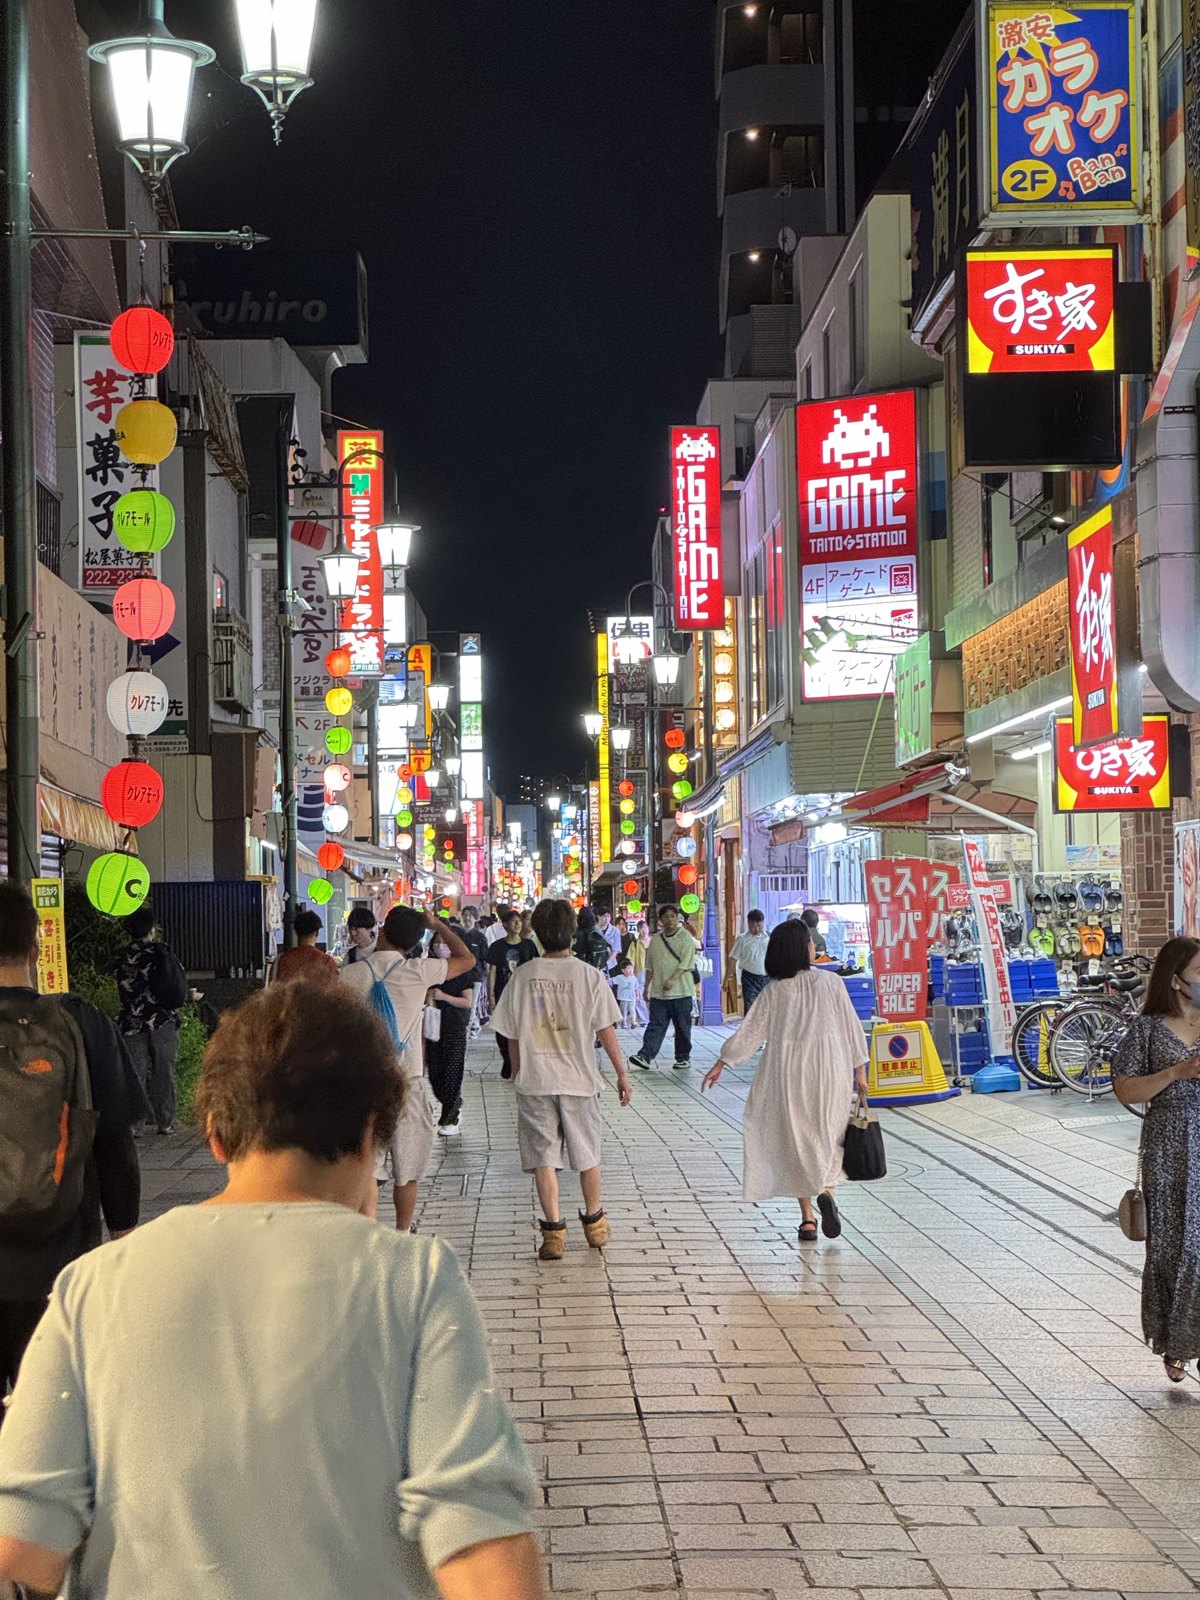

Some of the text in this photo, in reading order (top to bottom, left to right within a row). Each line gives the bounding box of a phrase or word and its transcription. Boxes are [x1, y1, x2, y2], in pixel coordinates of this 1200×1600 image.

[998, 13, 1054, 49] 激安
[1068, 153, 1116, 180] Ban
[1009, 169, 1049, 191] 2F
[1080, 166, 1126, 194] Ban
[183, 287, 327, 323] ruhiro
[984, 263, 1098, 342] すき家
[1015, 344, 1066, 354] SUKIYA
[83, 368, 128, 540] 芋菓子
[807, 469, 906, 533] GAME
[117, 511, 150, 527] クレアモール
[676, 465, 688, 620] TAITO STATION
[687, 465, 719, 620] GAME
[809, 529, 907, 554] TAITO STATION
[86, 570, 152, 585] 222-23
[828, 564, 887, 583] アーケード
[805, 577, 824, 595] 4F
[840, 583, 875, 598] ゲーム
[1076, 546, 1113, 682] すき家
[838, 657, 883, 671] クレーン
[294, 675, 331, 685] フジクラ
[131, 695, 165, 712] クレアモール
[314, 719, 331, 731] 2F
[1094, 786, 1133, 794] SUKIYA
[895, 867, 922, 960] スーパー
[879, 973, 922, 993] SUPER
[882, 993, 917, 1014] SALE
